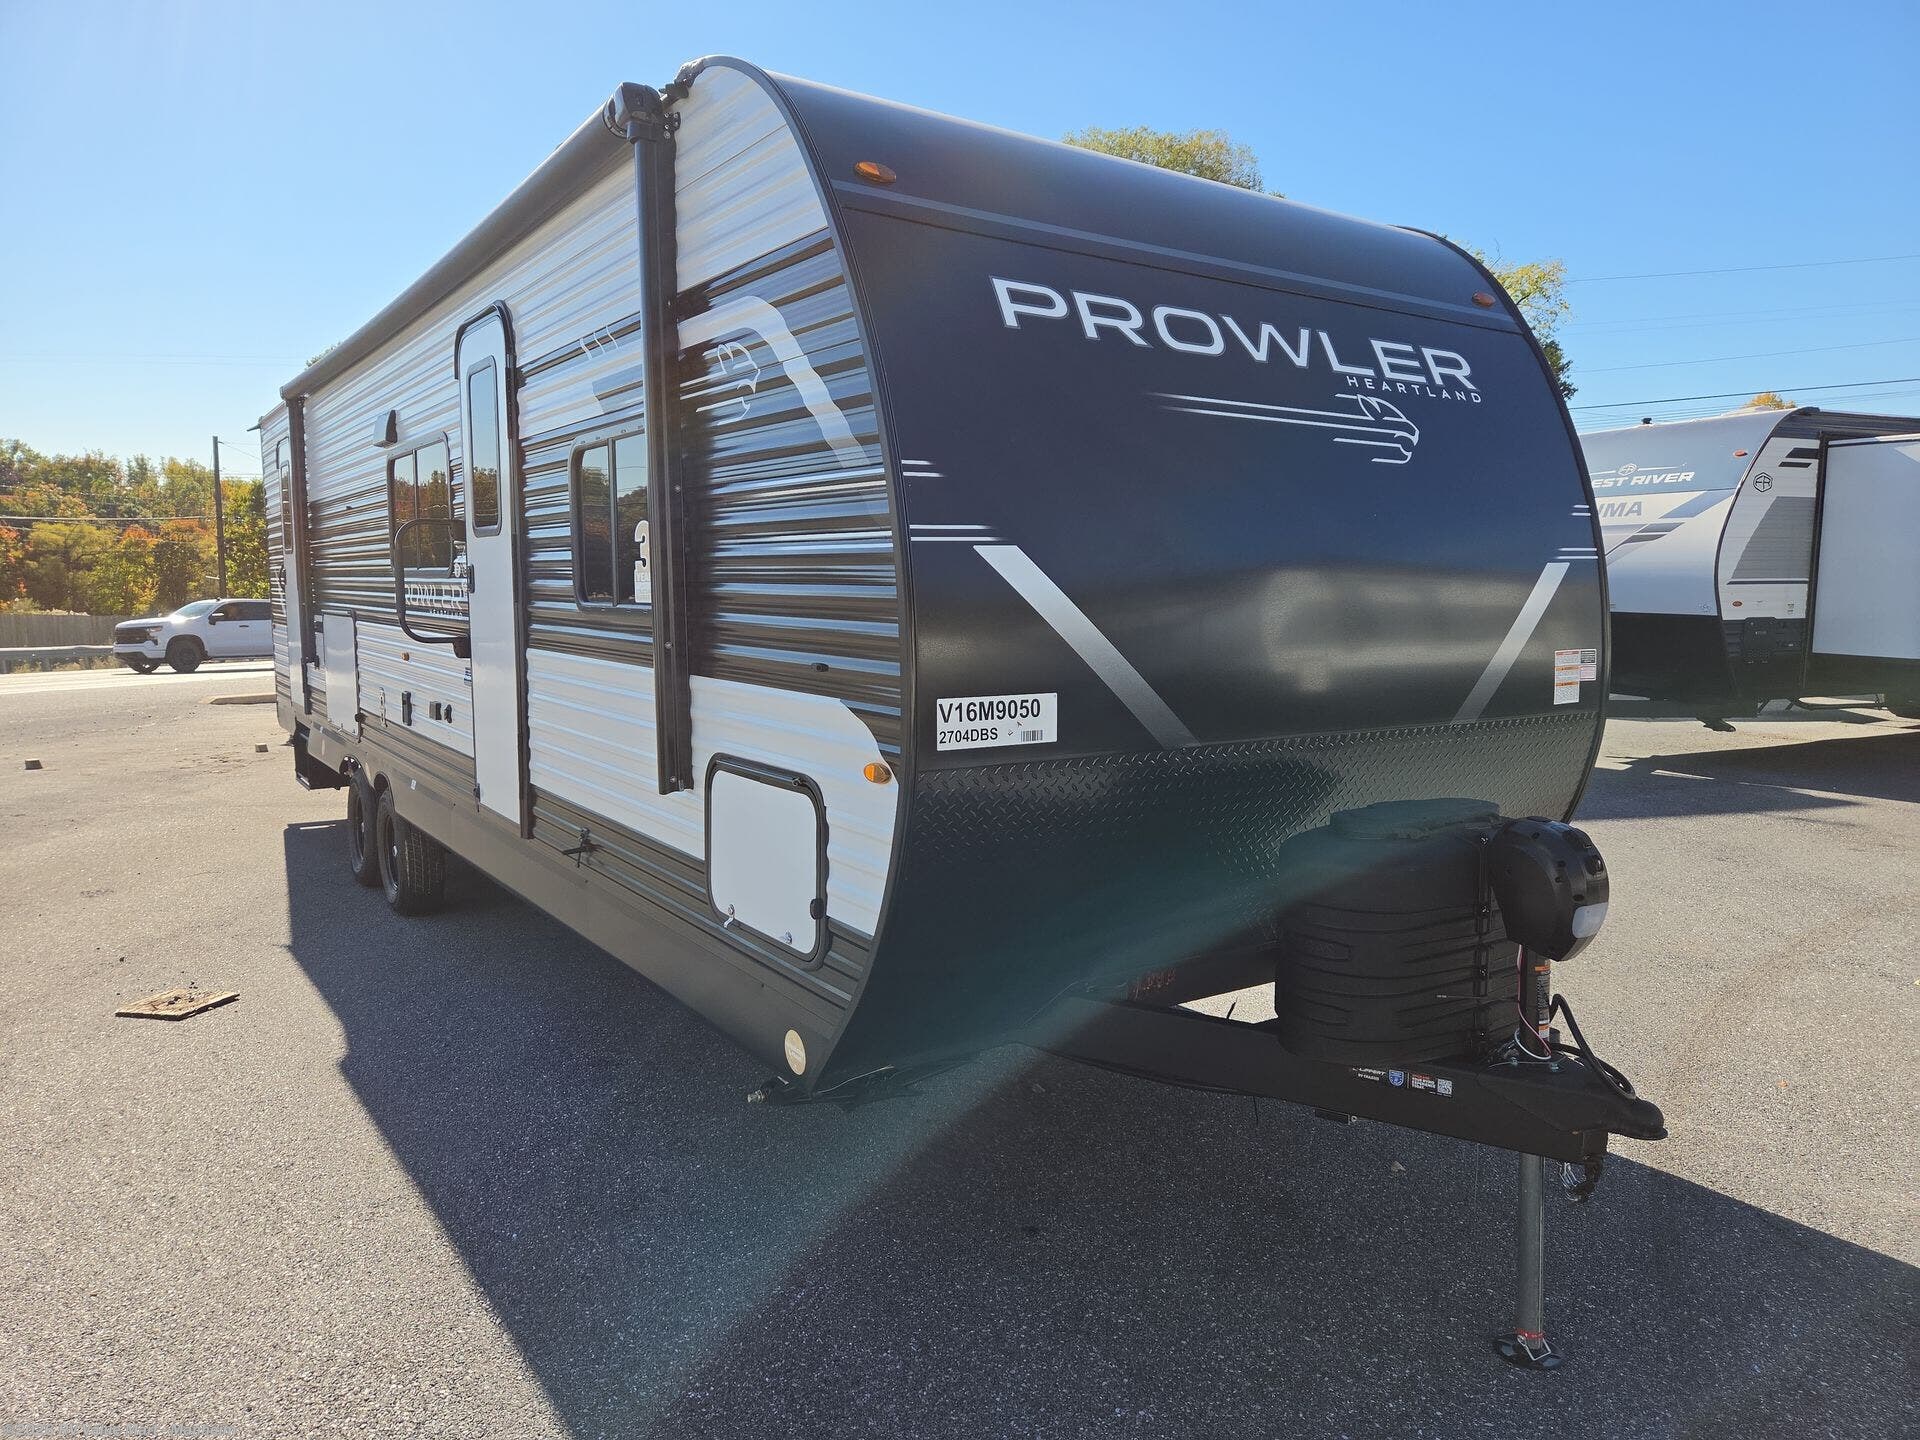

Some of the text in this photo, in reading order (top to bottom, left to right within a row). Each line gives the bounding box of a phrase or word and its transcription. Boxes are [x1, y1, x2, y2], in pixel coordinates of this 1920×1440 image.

[990, 276, 1478, 391] PROWLER
[1346, 375, 1482, 403] HEARTLAND
[1592, 471, 1696, 488] EST RIVER
[1599, 501, 1642, 518] MA
[939, 698, 1041, 723] V16M9050
[939, 727, 998, 744] 2704DBS
